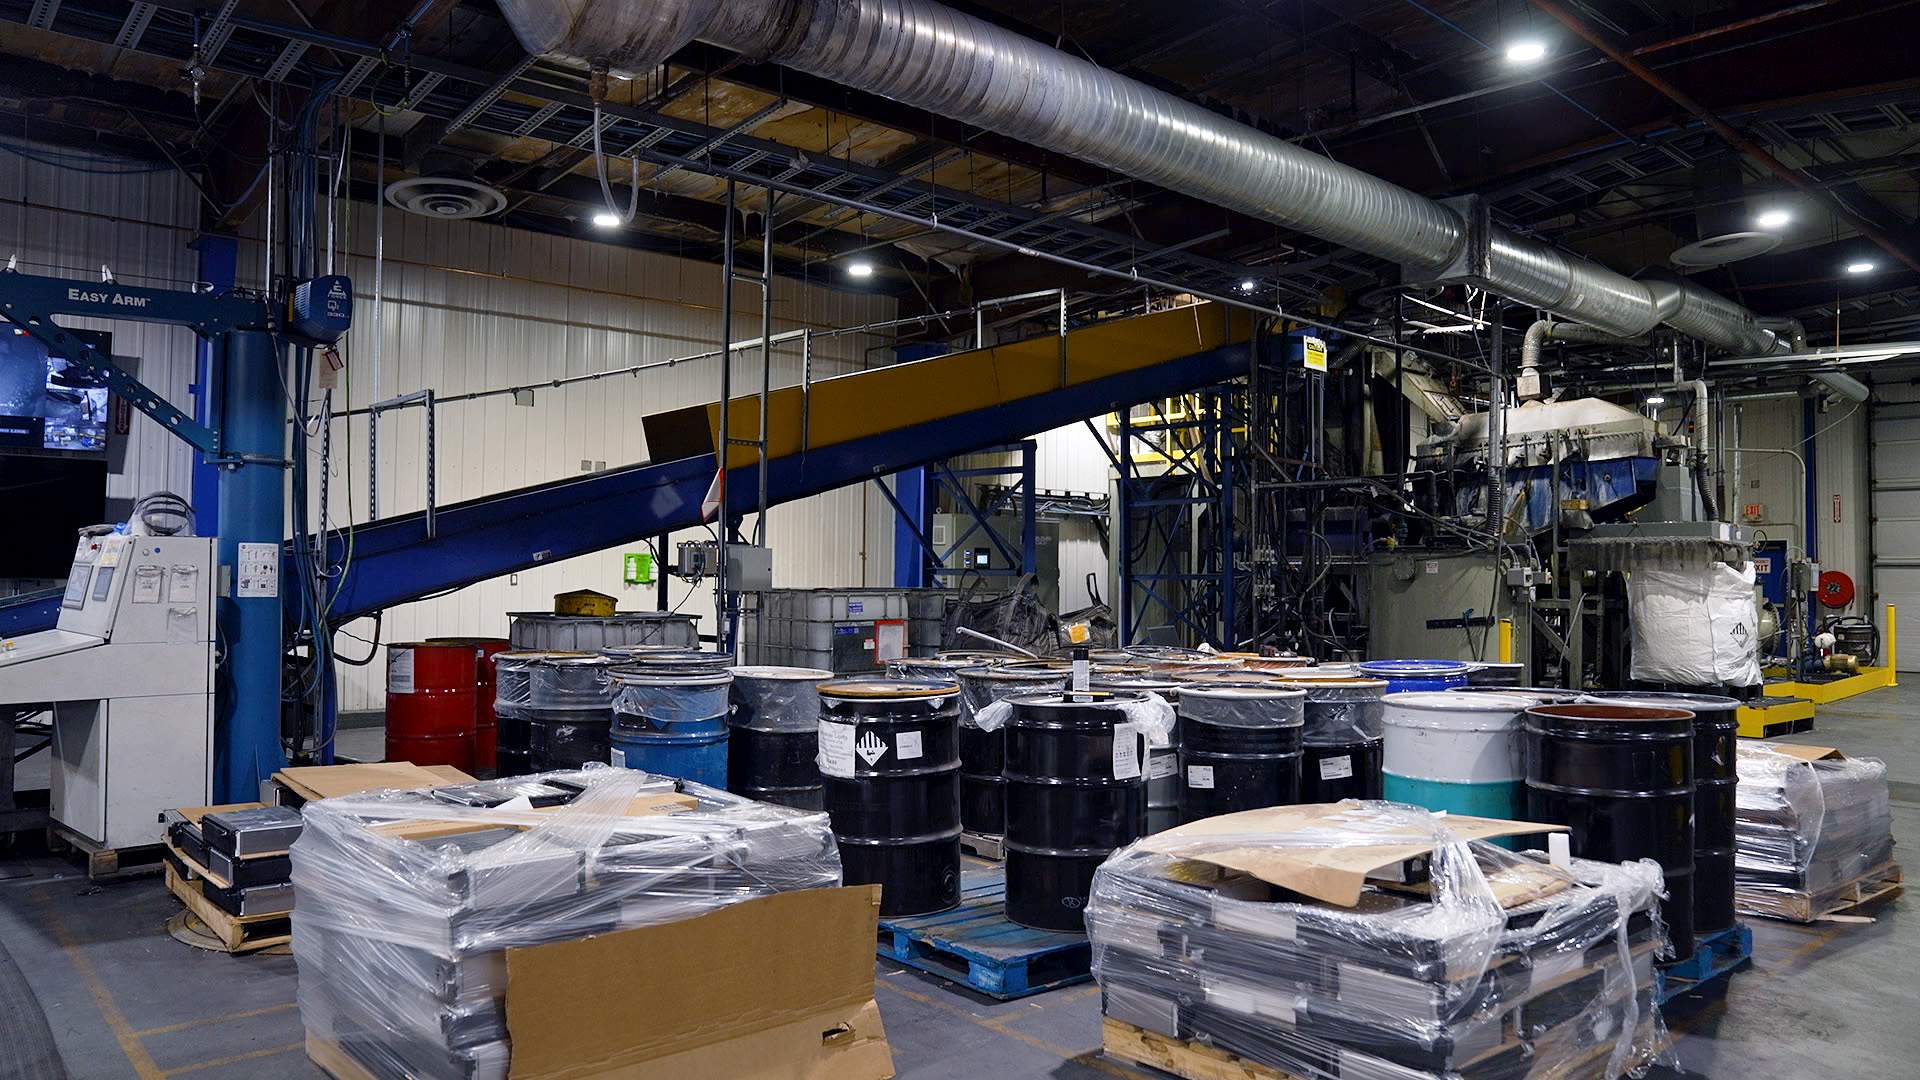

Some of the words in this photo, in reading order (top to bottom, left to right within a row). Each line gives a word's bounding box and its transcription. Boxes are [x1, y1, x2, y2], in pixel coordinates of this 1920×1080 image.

[68, 288, 108, 303] EASY
[1745, 504, 1760, 516] EXIT
[1755, 564, 1769, 572] XIT
